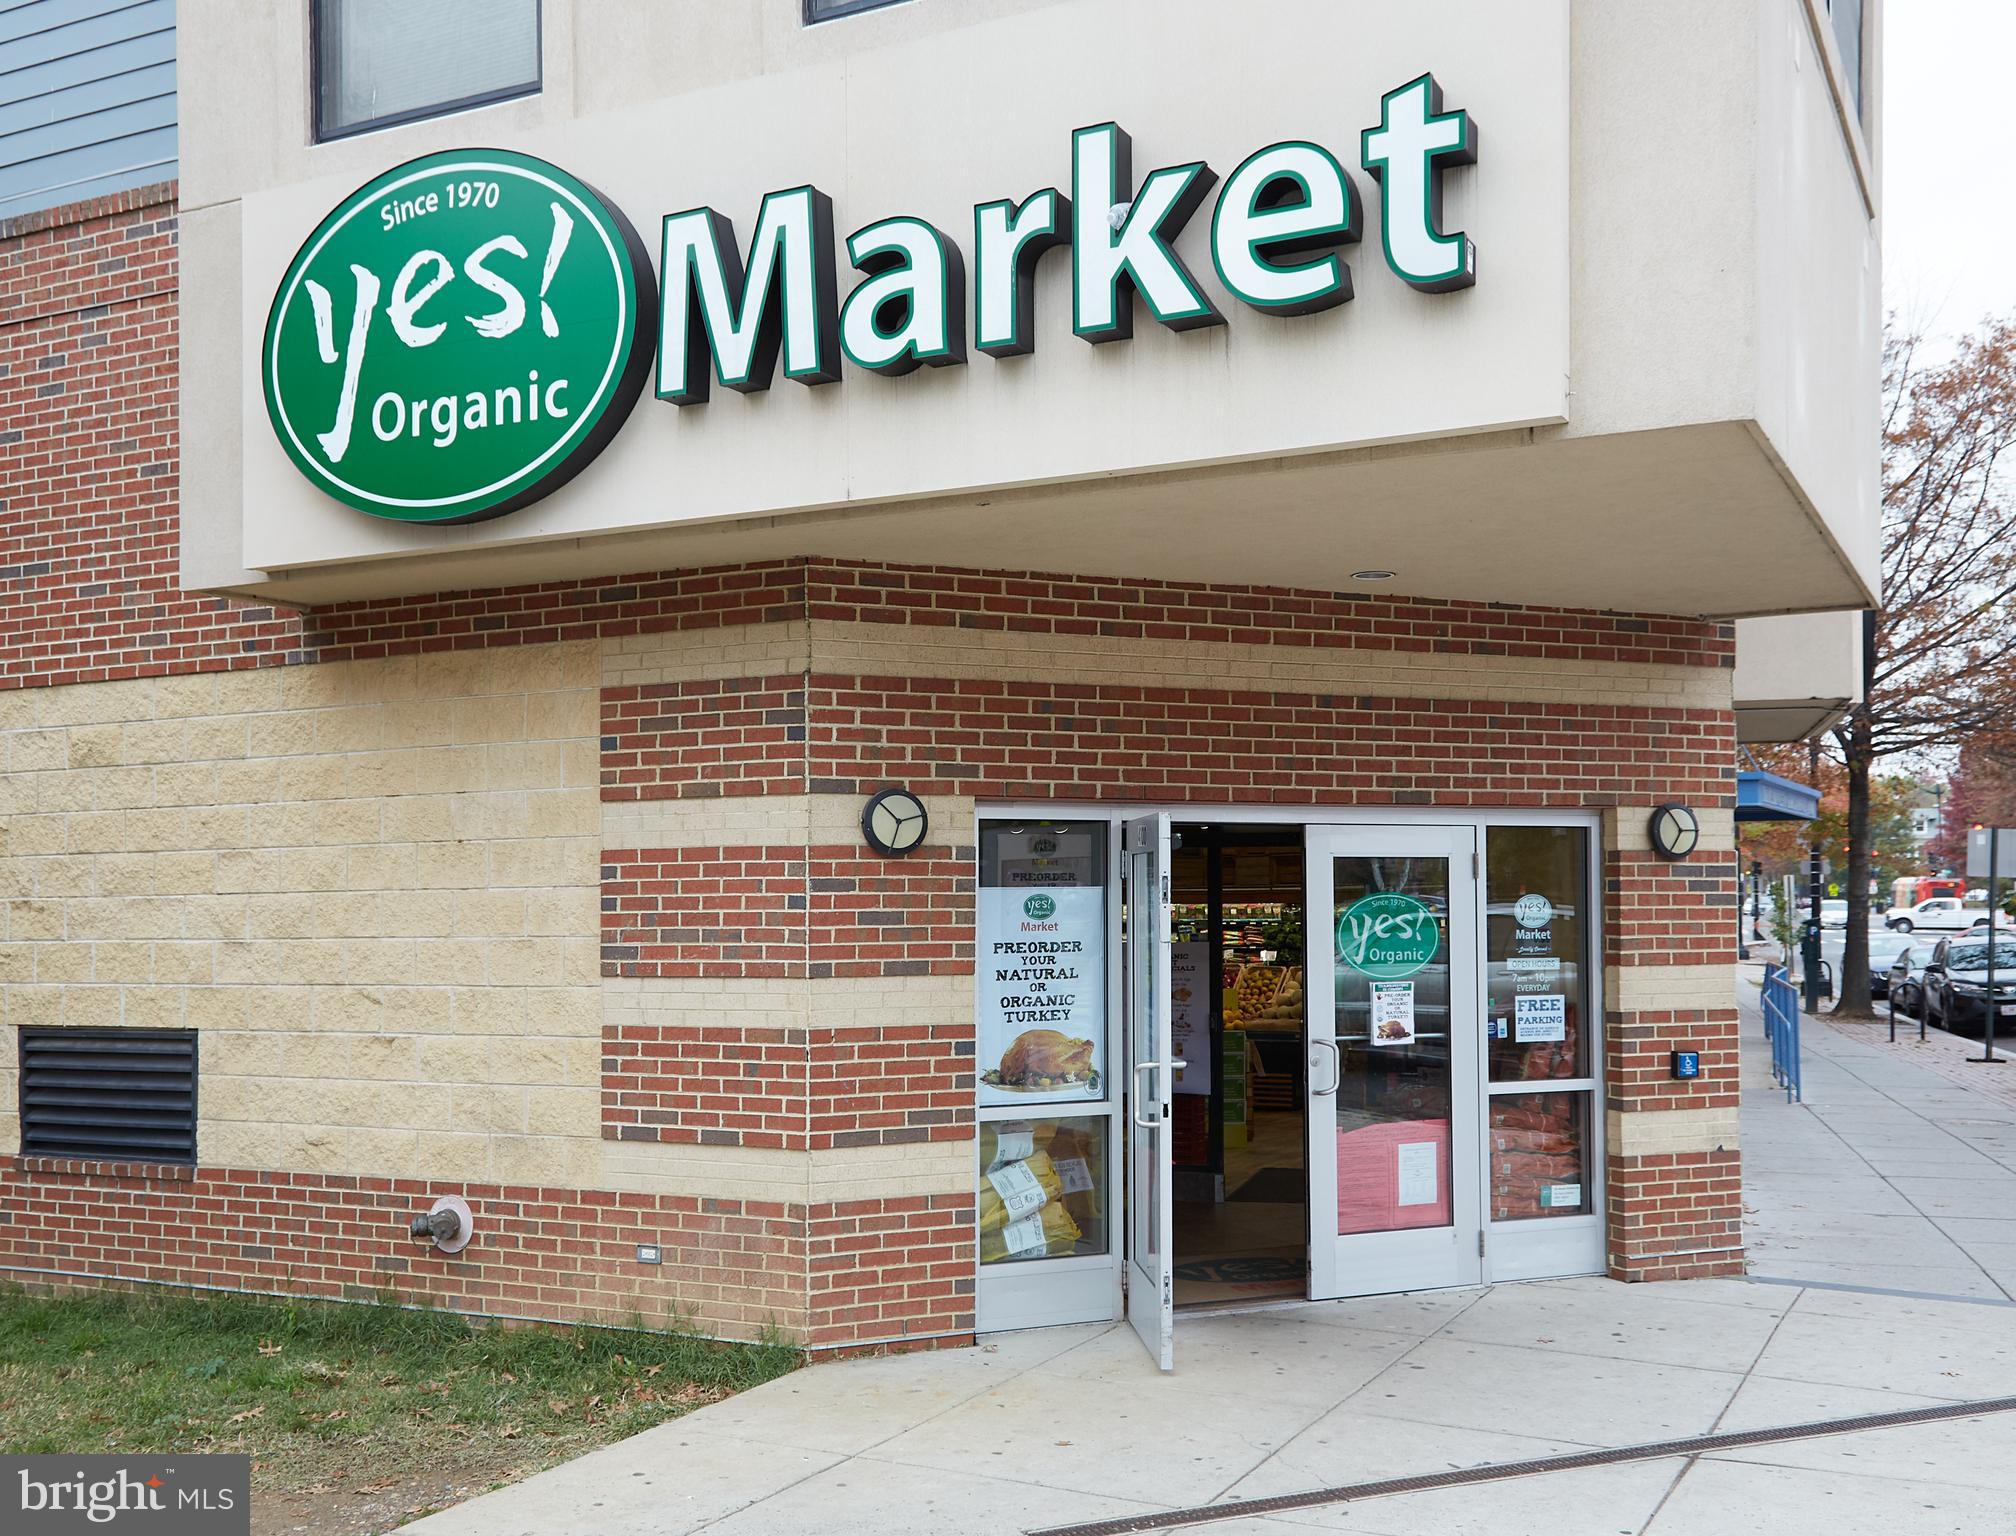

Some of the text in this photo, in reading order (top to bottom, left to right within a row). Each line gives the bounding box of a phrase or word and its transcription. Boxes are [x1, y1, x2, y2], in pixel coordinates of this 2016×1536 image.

[380, 181, 500, 231] Since 1970
[656, 72, 1474, 403] Market
[305, 202, 574, 463] yes!
[372, 369, 568, 447] Organic
[1012, 872, 1077, 881] PREORDER
[1371, 898, 1406, 908] Since 1970
[1519, 900, 1547, 921] yes!
[1021, 921, 1059, 932] Market
[1349, 908, 1426, 965] yes!
[1515, 929, 1551, 940] Market
[993, 941, 1083, 954] PREORDER
[1021, 956, 1056, 965] YOUR
[1369, 948, 1425, 964] Organic
[1512, 960, 1531, 968] OPEN
[995, 967, 1079, 981] NATURAL
[1029, 982, 1047, 992] OR
[1516, 984, 1550, 992] EVERYDAY
[1000, 994, 1076, 1008] ORGANIC
[1517, 999, 1561, 1012] FREE
[1004, 1009, 1071, 1023] TURKEY
[1517, 1015, 1563, 1025] PARKING
